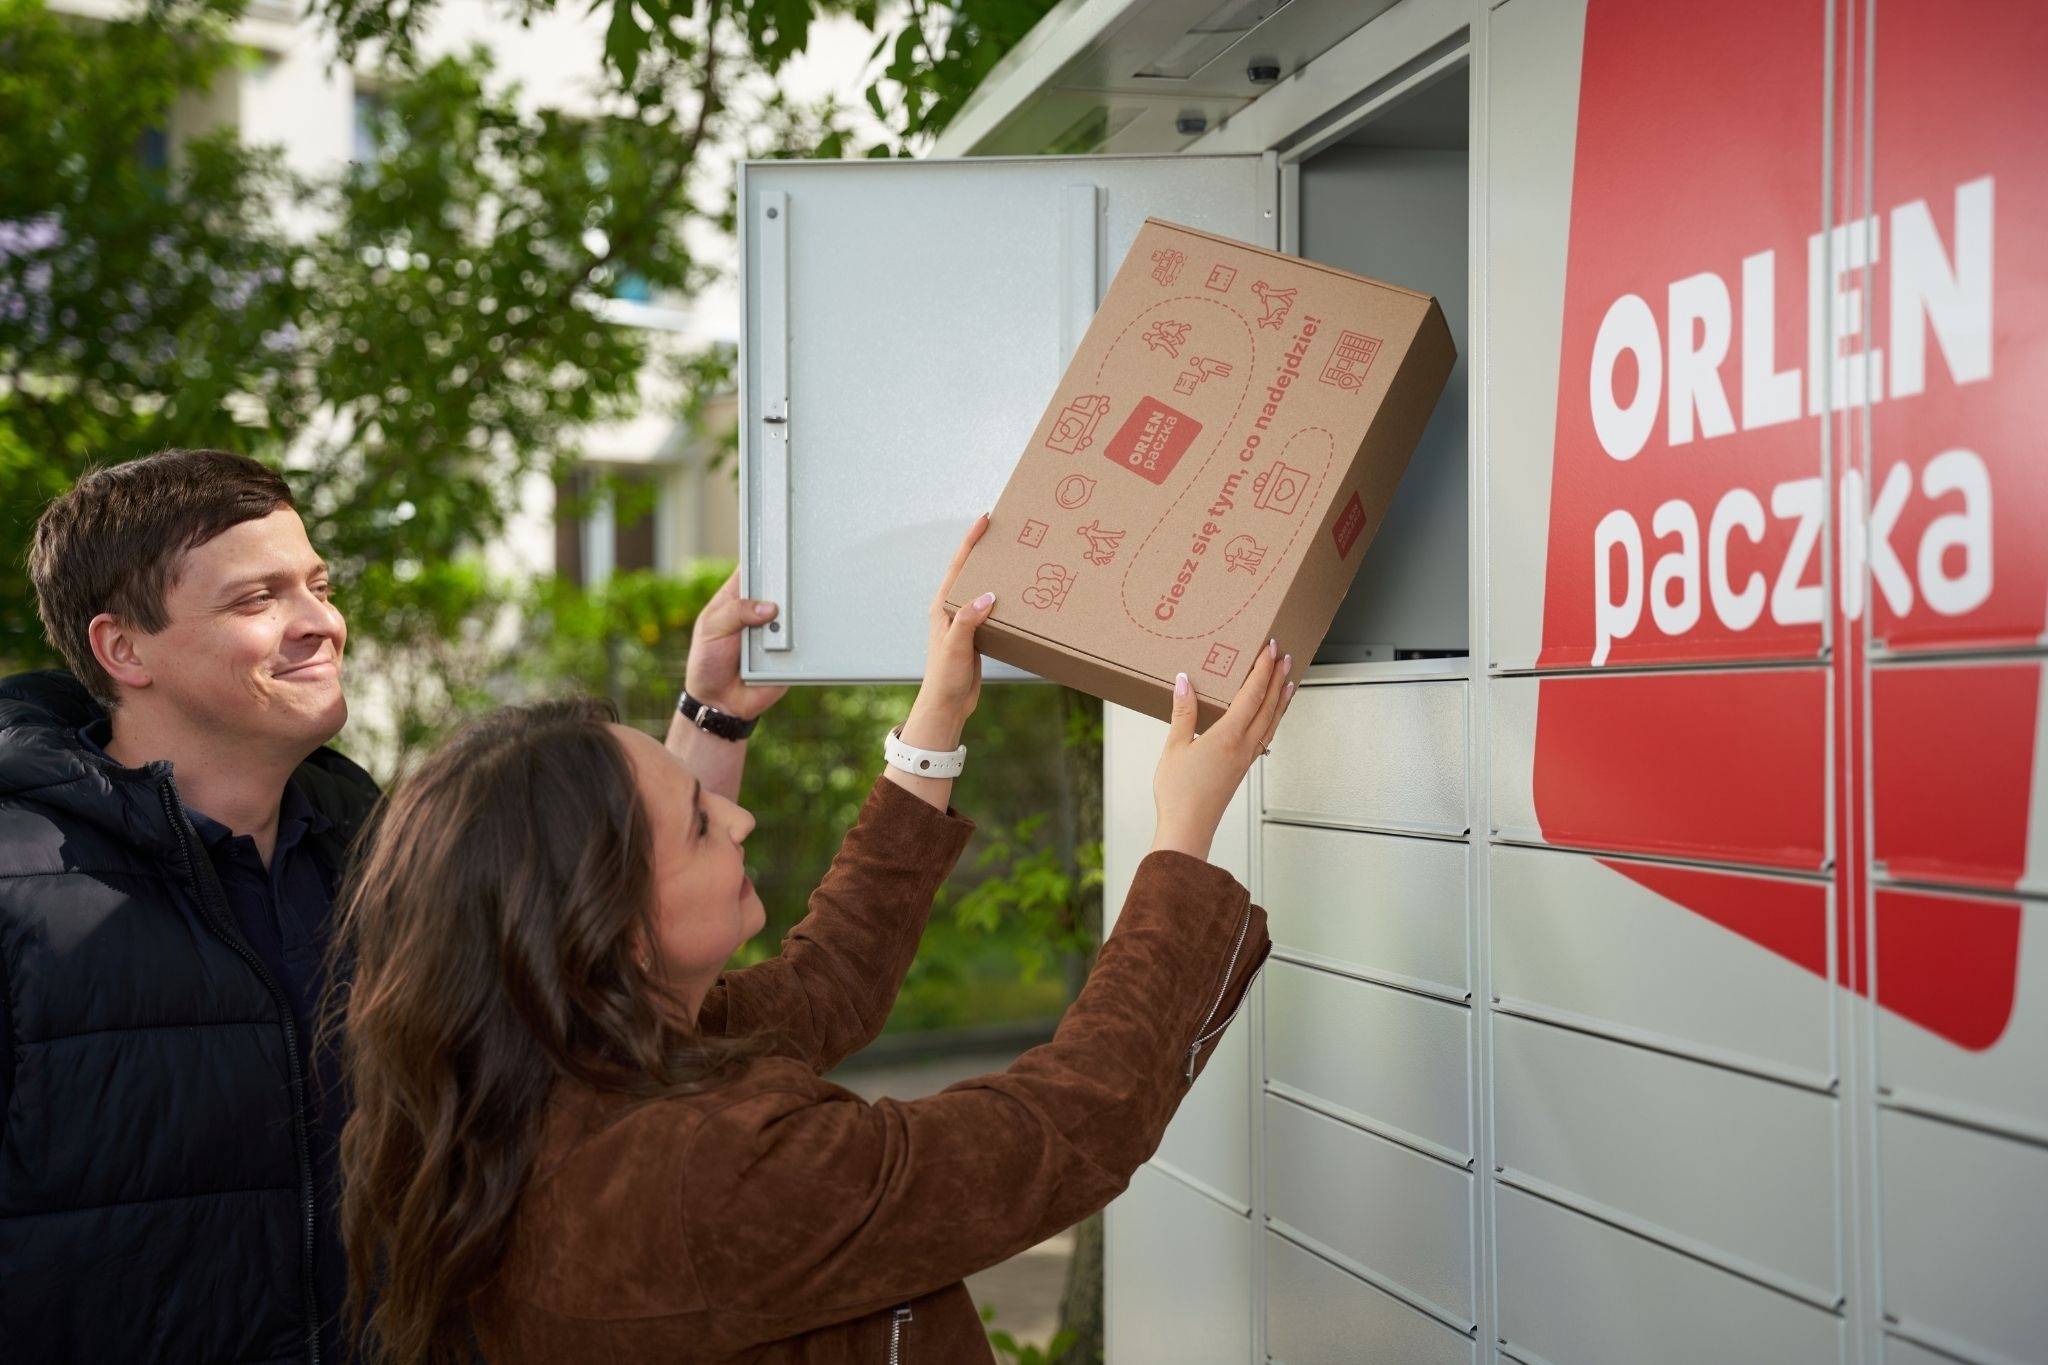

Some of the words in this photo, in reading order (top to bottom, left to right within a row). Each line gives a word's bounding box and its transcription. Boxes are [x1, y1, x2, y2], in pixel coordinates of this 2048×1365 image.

[1590, 174, 1995, 462] ORLEN
[1129, 411, 1165, 465] ORLEN
[1143, 416, 1178, 471] paczka
[1154, 558, 1199, 621] Ciesz
[1192, 521, 1221, 556] się
[1207, 469, 1249, 517] tym,
[1239, 434, 1261, 462] co
[1254, 315, 1321, 430] nadejdzie!
[1590, 448, 1994, 667] paczka
